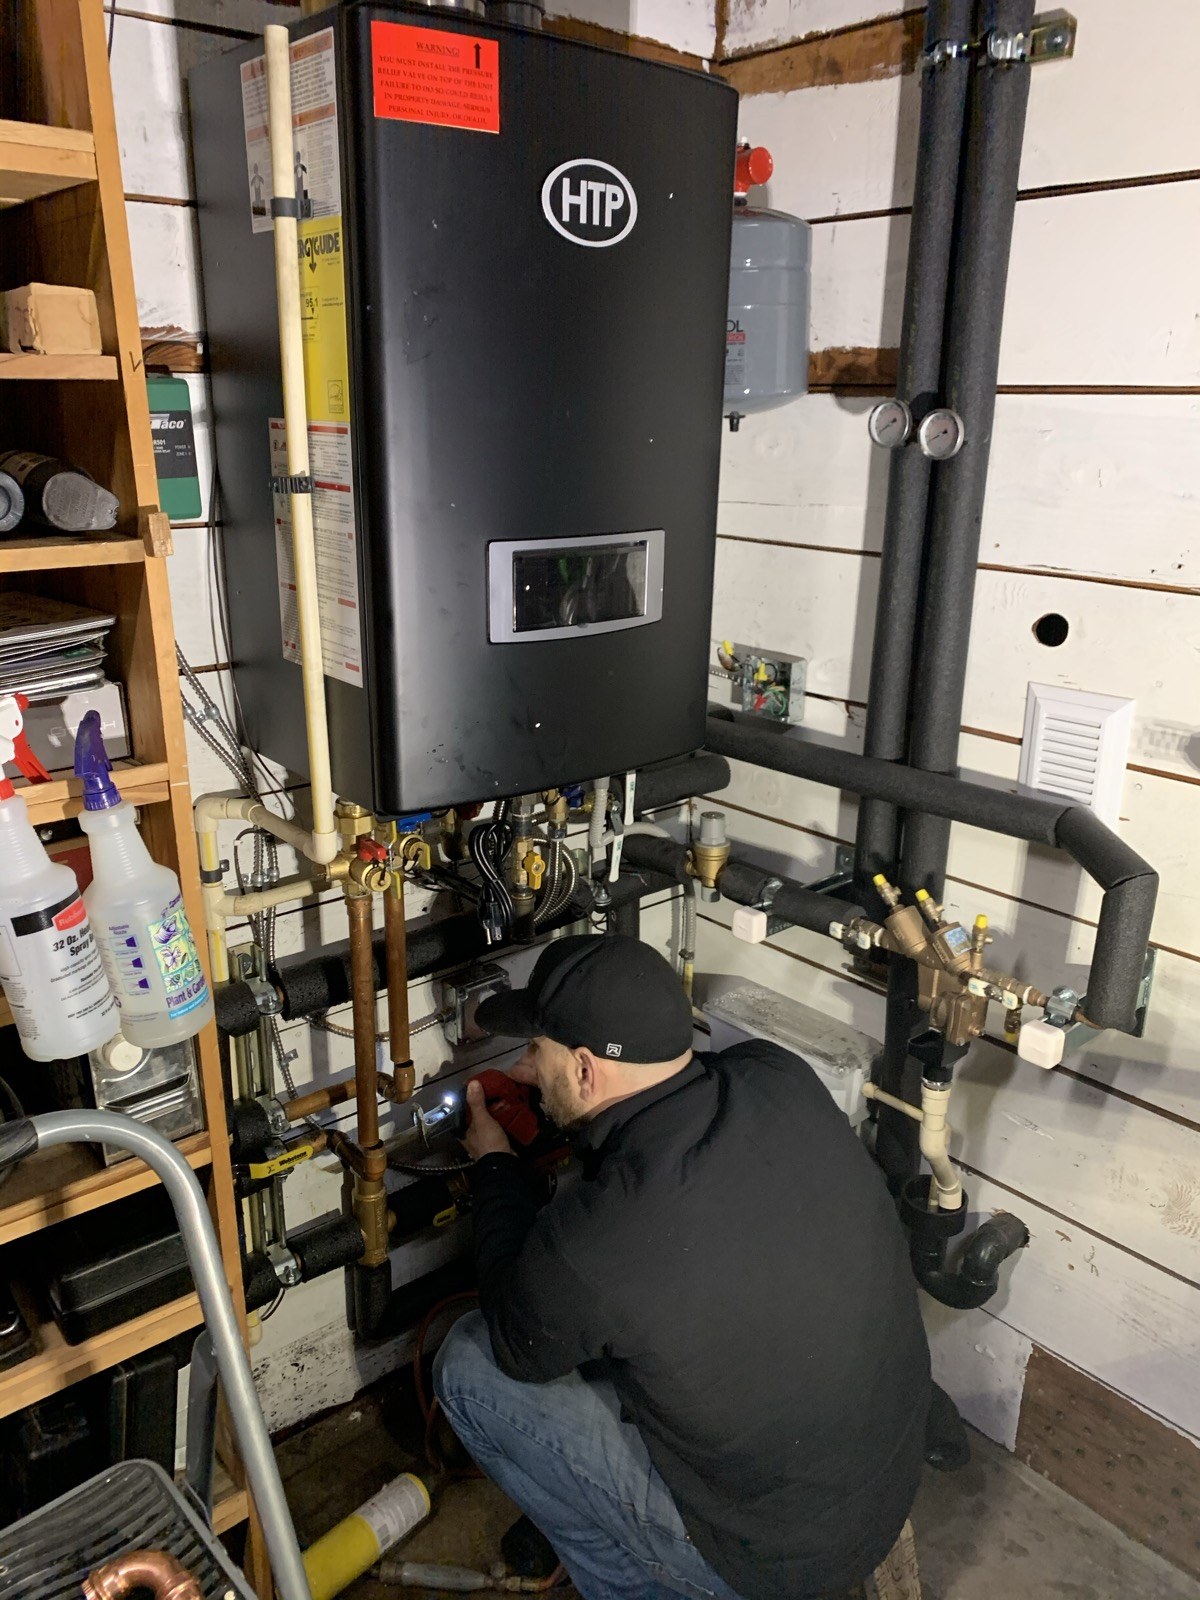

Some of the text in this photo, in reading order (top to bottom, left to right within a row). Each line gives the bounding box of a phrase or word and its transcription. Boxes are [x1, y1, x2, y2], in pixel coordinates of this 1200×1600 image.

[416, 42, 460, 57] WARNING!
[378, 67, 400, 77] RELIEF
[402, 70, 425, 80] VALVE
[427, 74, 438, 82] ON
[440, 76, 453, 84] TOP
[464, 80, 476, 88] THE
[396, 57, 416, 67] MUST
[418, 60, 446, 71] INSTALL
[448, 65, 460, 73] THE
[462, 67, 493, 79] PRESSURE
[380, 80, 409, 90] FAILURE
[412, 83, 422, 91] TO
[445, 89, 468, 98] COULD
[470, 92, 493, 102] RESULT
[384, 92, 393, 100] IN
[395, 93, 429, 104] PROPERTY
[463, 103, 490, 113] SERIOUS
[388, 105, 424, 116] PERSONAL
[562, 177, 625, 228] HTP
[298, 232, 340, 259] RGYGUIDE
[305, 297, 318, 307] 95.1
[150, 413, 185, 430] Taco
[53, 939, 65, 952] 32
[66, 934, 79, 946] Oz.
[70, 938, 89, 957] Spray
[165, 990, 187, 1008] Plant
[186, 987, 193, 998] &
